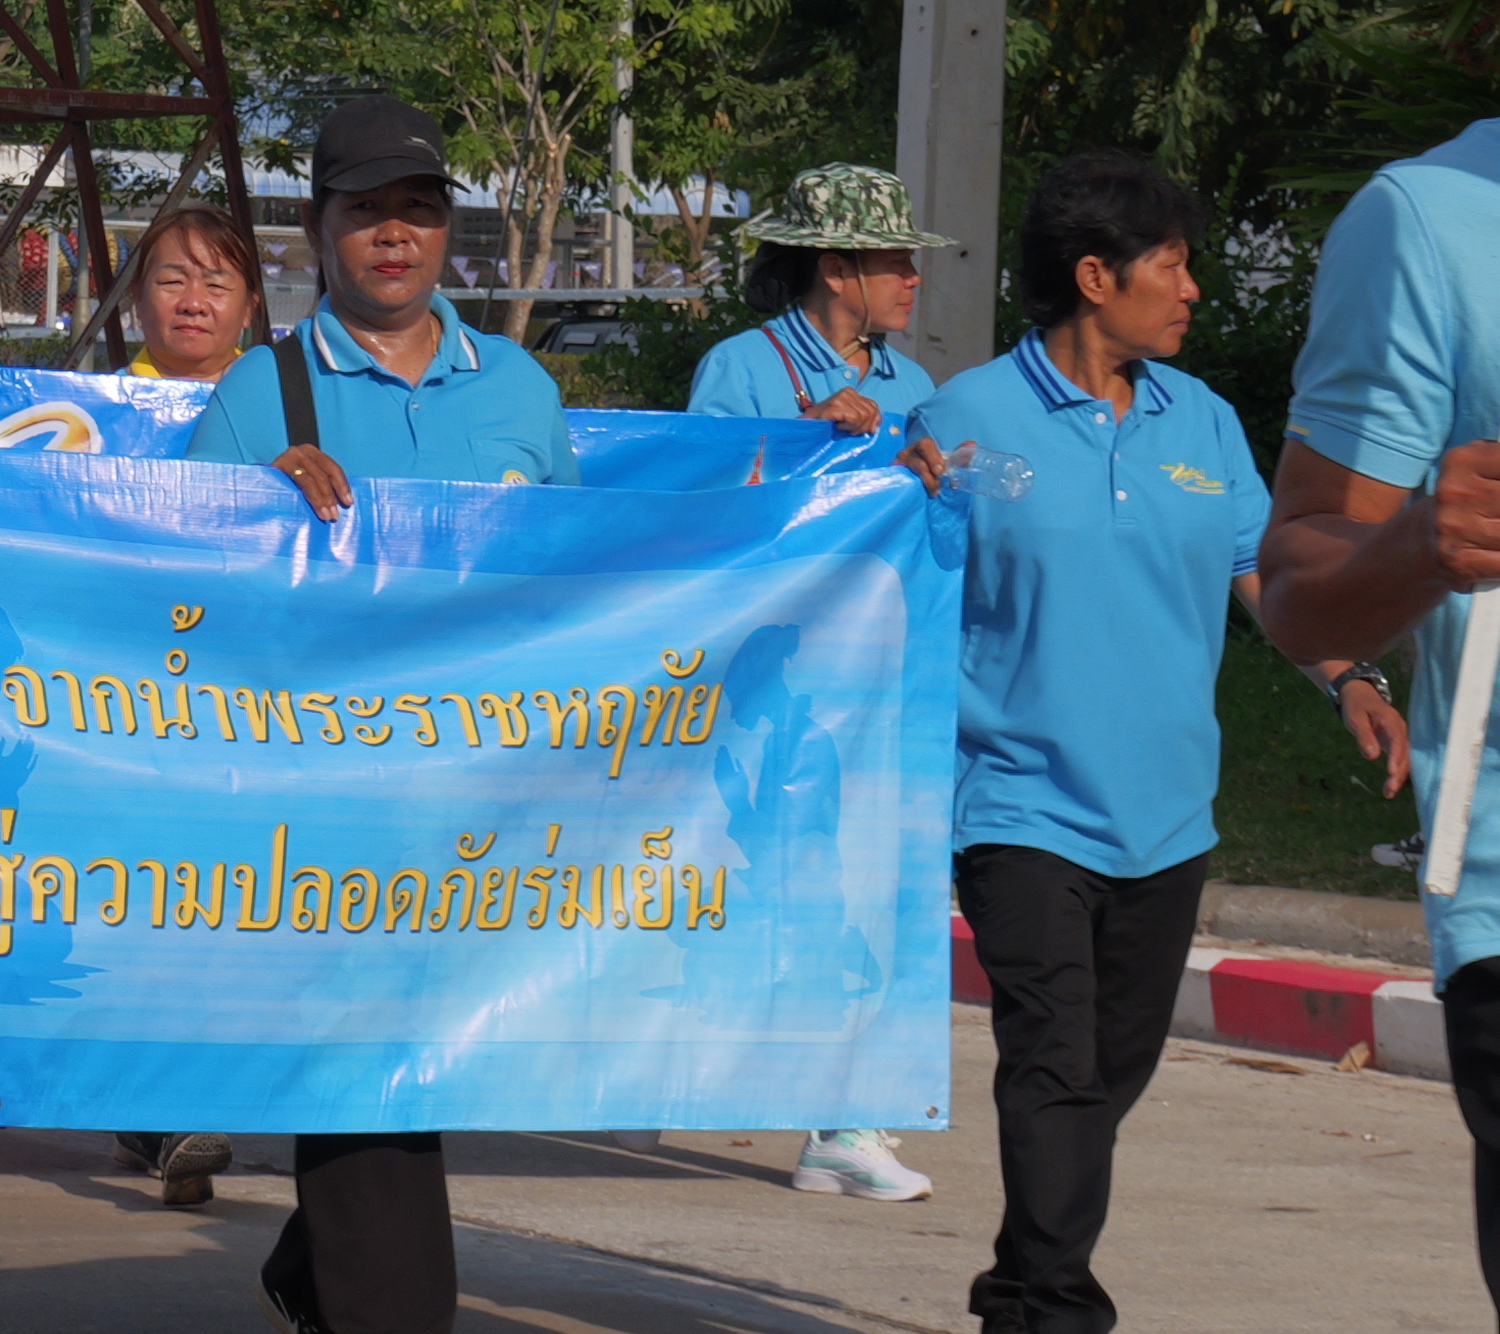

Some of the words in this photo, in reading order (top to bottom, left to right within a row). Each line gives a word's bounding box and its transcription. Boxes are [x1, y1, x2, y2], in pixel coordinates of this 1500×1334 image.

[1, 603, 723, 778] จากน้ำพระราชหฤทัย
